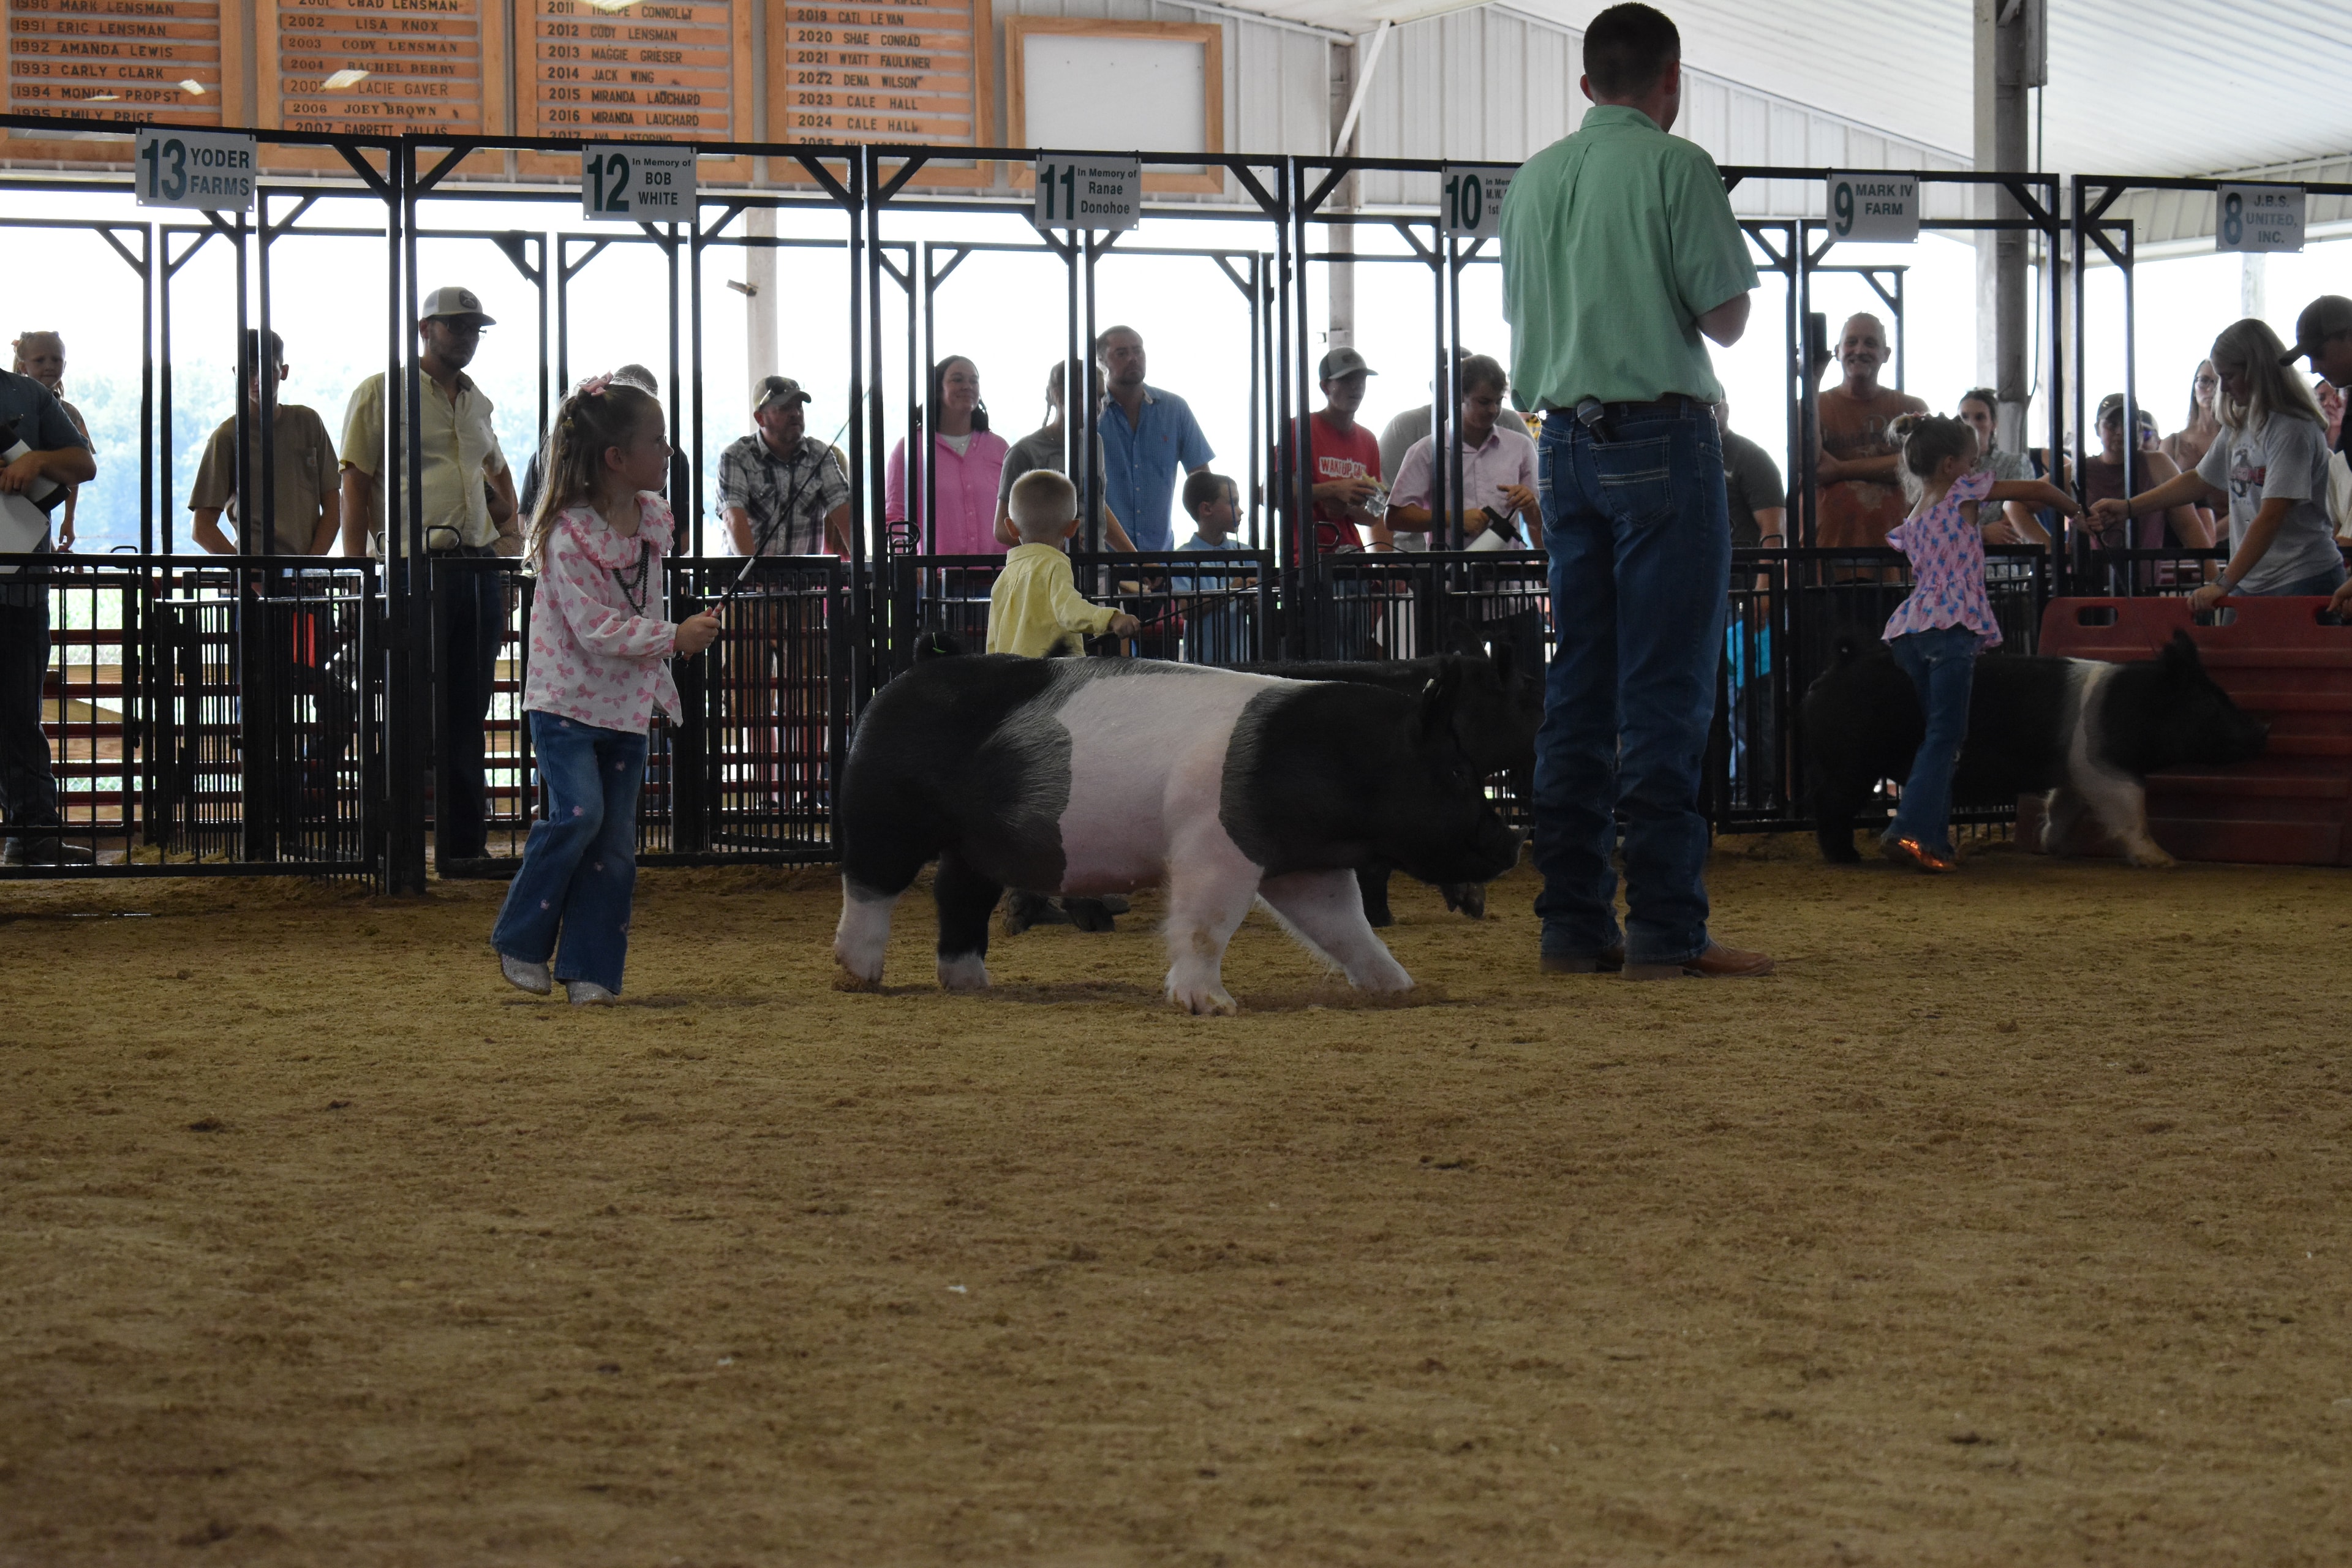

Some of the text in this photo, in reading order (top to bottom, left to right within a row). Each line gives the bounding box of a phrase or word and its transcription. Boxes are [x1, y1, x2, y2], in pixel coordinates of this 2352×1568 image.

[15, 0, 175, 15] 1990 MARK LENSMAN
[393, 0, 458, 11] LENSMAN
[548, 1, 575, 14] 2011
[641, 6, 693, 20] CONNOLLY
[797, 9, 827, 22] 2019
[16, 21, 166, 37] 1991 ERIC LENSMAN
[288, 16, 439, 32] 2002 LISA KNOX
[548, 24, 677, 41] 2012 CODY LENSMAN
[798, 30, 921, 47] 2020 SHAE CONRAD
[15, 42, 173, 58] 1992 AMANDA LEWIS
[288, 39, 458, 53] 2003 CODY LENSMAN
[548, 45, 682, 62] 2013 MAGGIE GRIESER
[291, 59, 456, 75] 2004 RACHEL BERRY
[798, 51, 931, 69] 2021 WYATT FAULKNER
[16, 63, 164, 79] 1993 CARLY CLARK
[548, 67, 654, 83] 2014 JACK WING
[291, 80, 448, 96] 2005 LACIE GAVER
[798, 72, 918, 88] 2022 DENA WILSON
[16, 86, 180, 102] 1994 MONICA PROPST
[549, 88, 701, 106] 2015 MIRANDA LAUCHARD
[799, 93, 919, 110] 2023 CALE HALL
[61, 110, 102, 119] EMILY
[114, 111, 154, 123] PRICE
[293, 104, 437, 118] 2006 JOEY BROWN
[549, 110, 699, 127] 2016 MIRANDA LAUCHARD
[295, 123, 448, 136] 2007 GARRETT DALLAS
[799, 115, 919, 132] 2024 CALE HALL
[190, 148, 249, 168] YODER
[644, 159, 679, 168] Memory
[141, 138, 187, 201] 13
[1077, 168, 1086, 176] In
[1089, 168, 1125, 179] Memory
[190, 175, 249, 197] FARMS
[587, 153, 630, 212] 12
[646, 172, 671, 186] BOB
[1040, 164, 1075, 221] 11
[1088, 181, 1123, 195] Ranae
[1486, 189, 1502, 199] M.W.
[1855, 184, 1913, 197] MARK IV
[638, 191, 678, 205] WHITE
[1445, 174, 1482, 230] 10
[2254, 195, 2290, 208] J.B.S.
[1080, 200, 1130, 214] Donohoe
[1488, 205, 1499, 214] 1st
[1834, 181, 1854, 236] 9
[1865, 203, 1903, 215] FARM
[2223, 192, 2243, 245] 8
[2245, 212, 2297, 228] UNITED,
[2258, 230, 2285, 243] INC.
